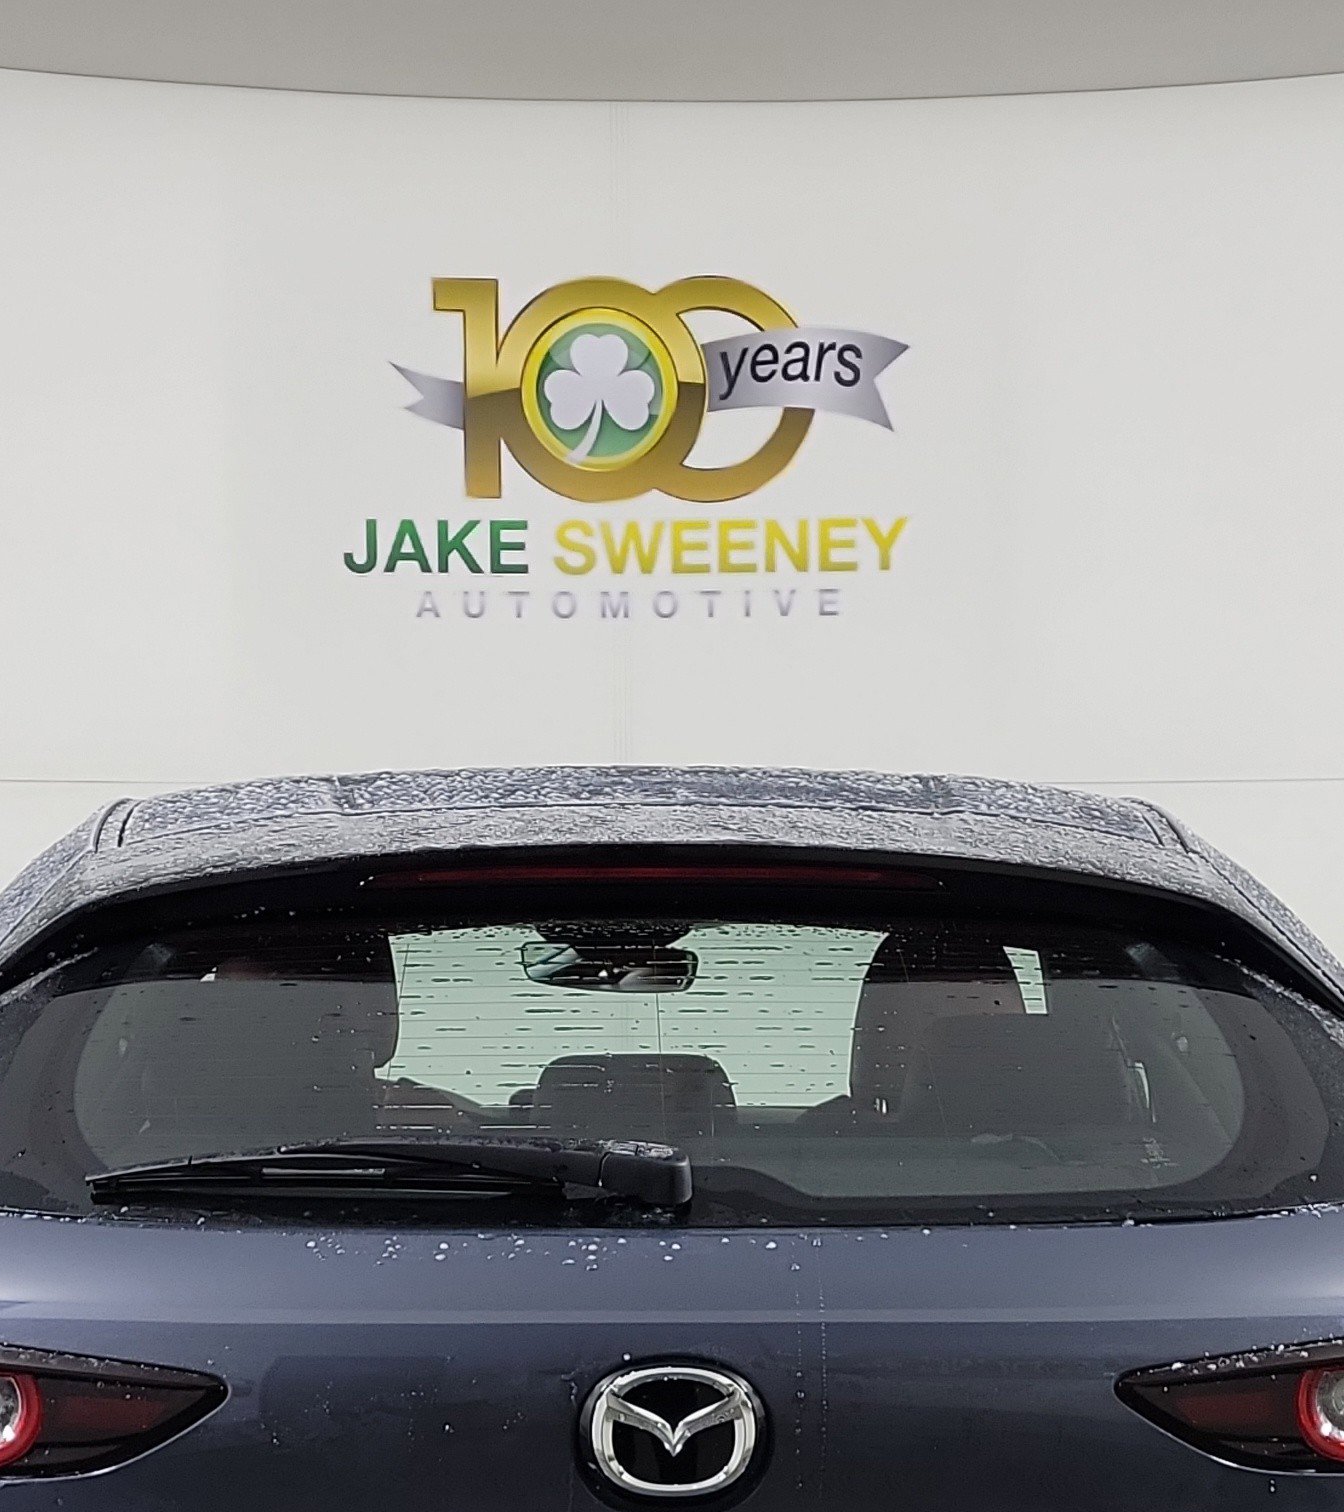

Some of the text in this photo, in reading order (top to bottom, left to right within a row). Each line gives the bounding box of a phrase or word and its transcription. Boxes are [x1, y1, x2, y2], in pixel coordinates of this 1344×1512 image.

[431, 275, 864, 503] 100 years
[343, 515, 909, 576] JAKE SWEENEY
[415, 588, 843, 619] AUTOMOTIVE
